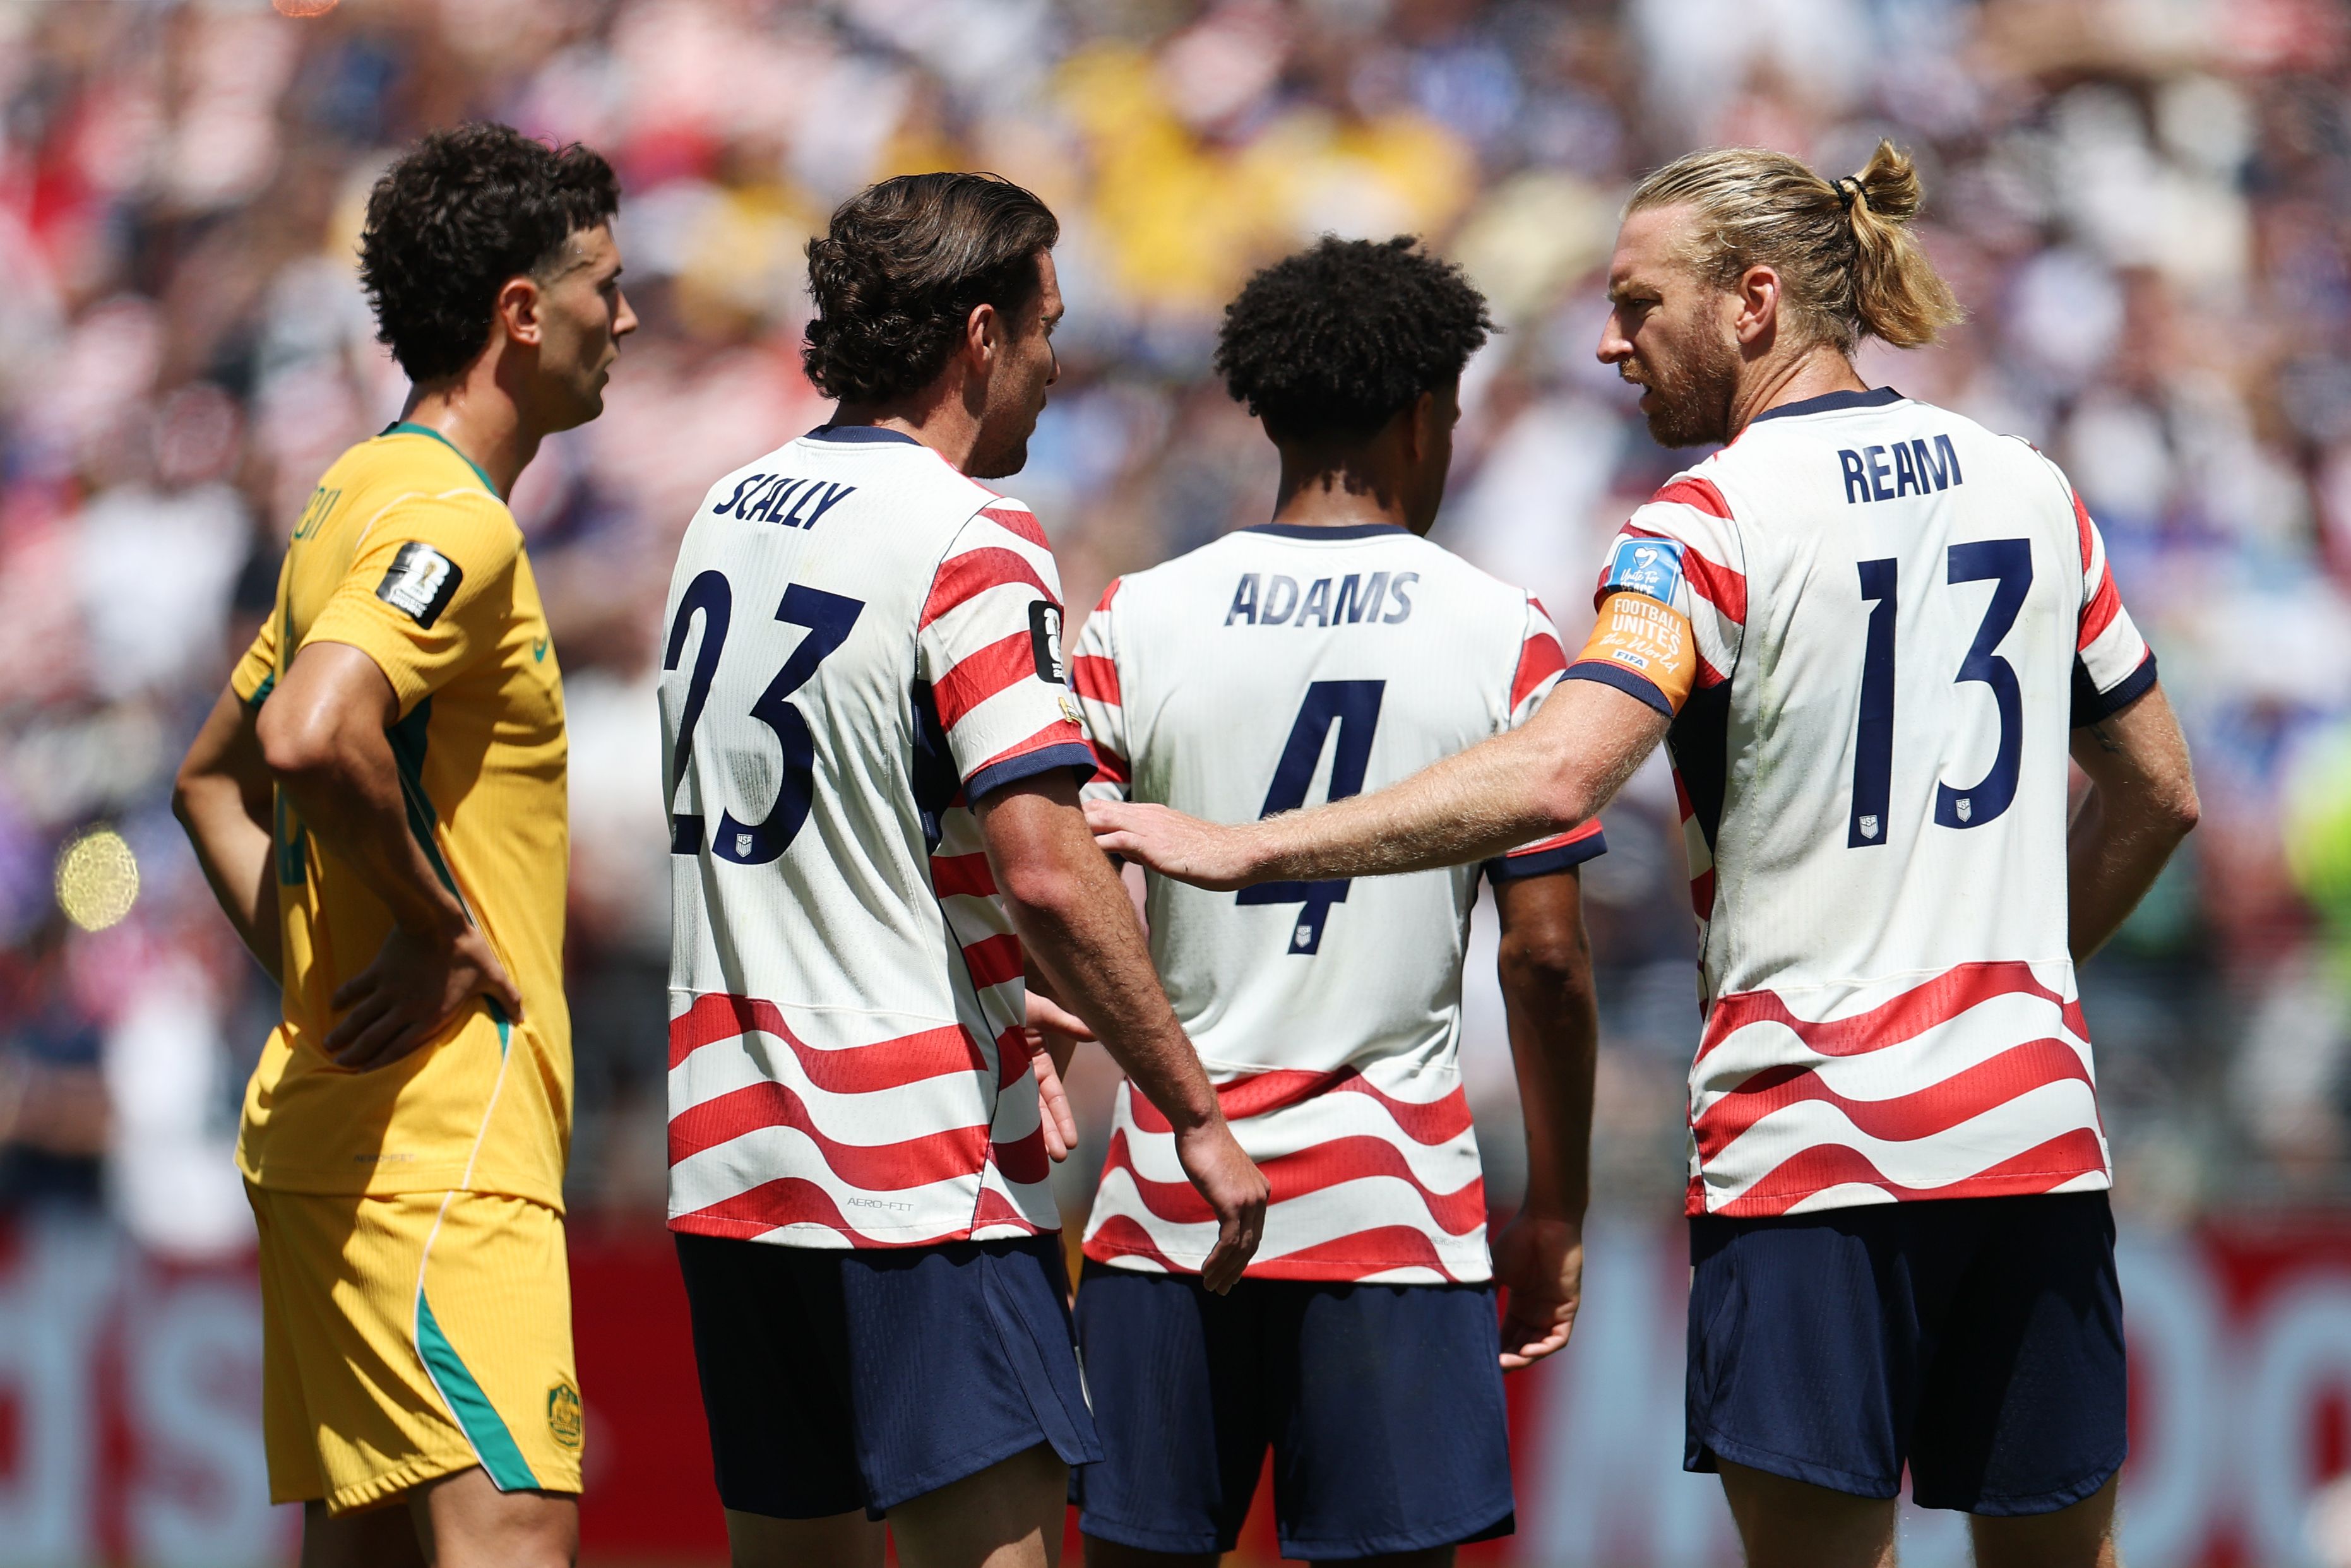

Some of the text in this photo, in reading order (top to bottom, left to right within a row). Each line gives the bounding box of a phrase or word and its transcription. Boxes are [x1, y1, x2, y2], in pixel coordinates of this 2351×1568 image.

[1837, 434, 1963, 504] REAM
[713, 473, 858, 530] SCALLY
[1620, 581, 1655, 595] PEACE
[1621, 568, 1660, 584] Unite For
[1223, 571, 1420, 627] ADAMS
[1614, 598, 1682, 638] FOOTBALL
[1598, 632, 1679, 674] the World
[1611, 614, 1681, 655] UNITES
[1616, 651, 1645, 667] FIFA
[1847, 538, 2033, 848] 13
[664, 569, 866, 865] 23
[1235, 680, 1386, 955] 4
[847, 1197, 914, 1211] AERO-FIT
